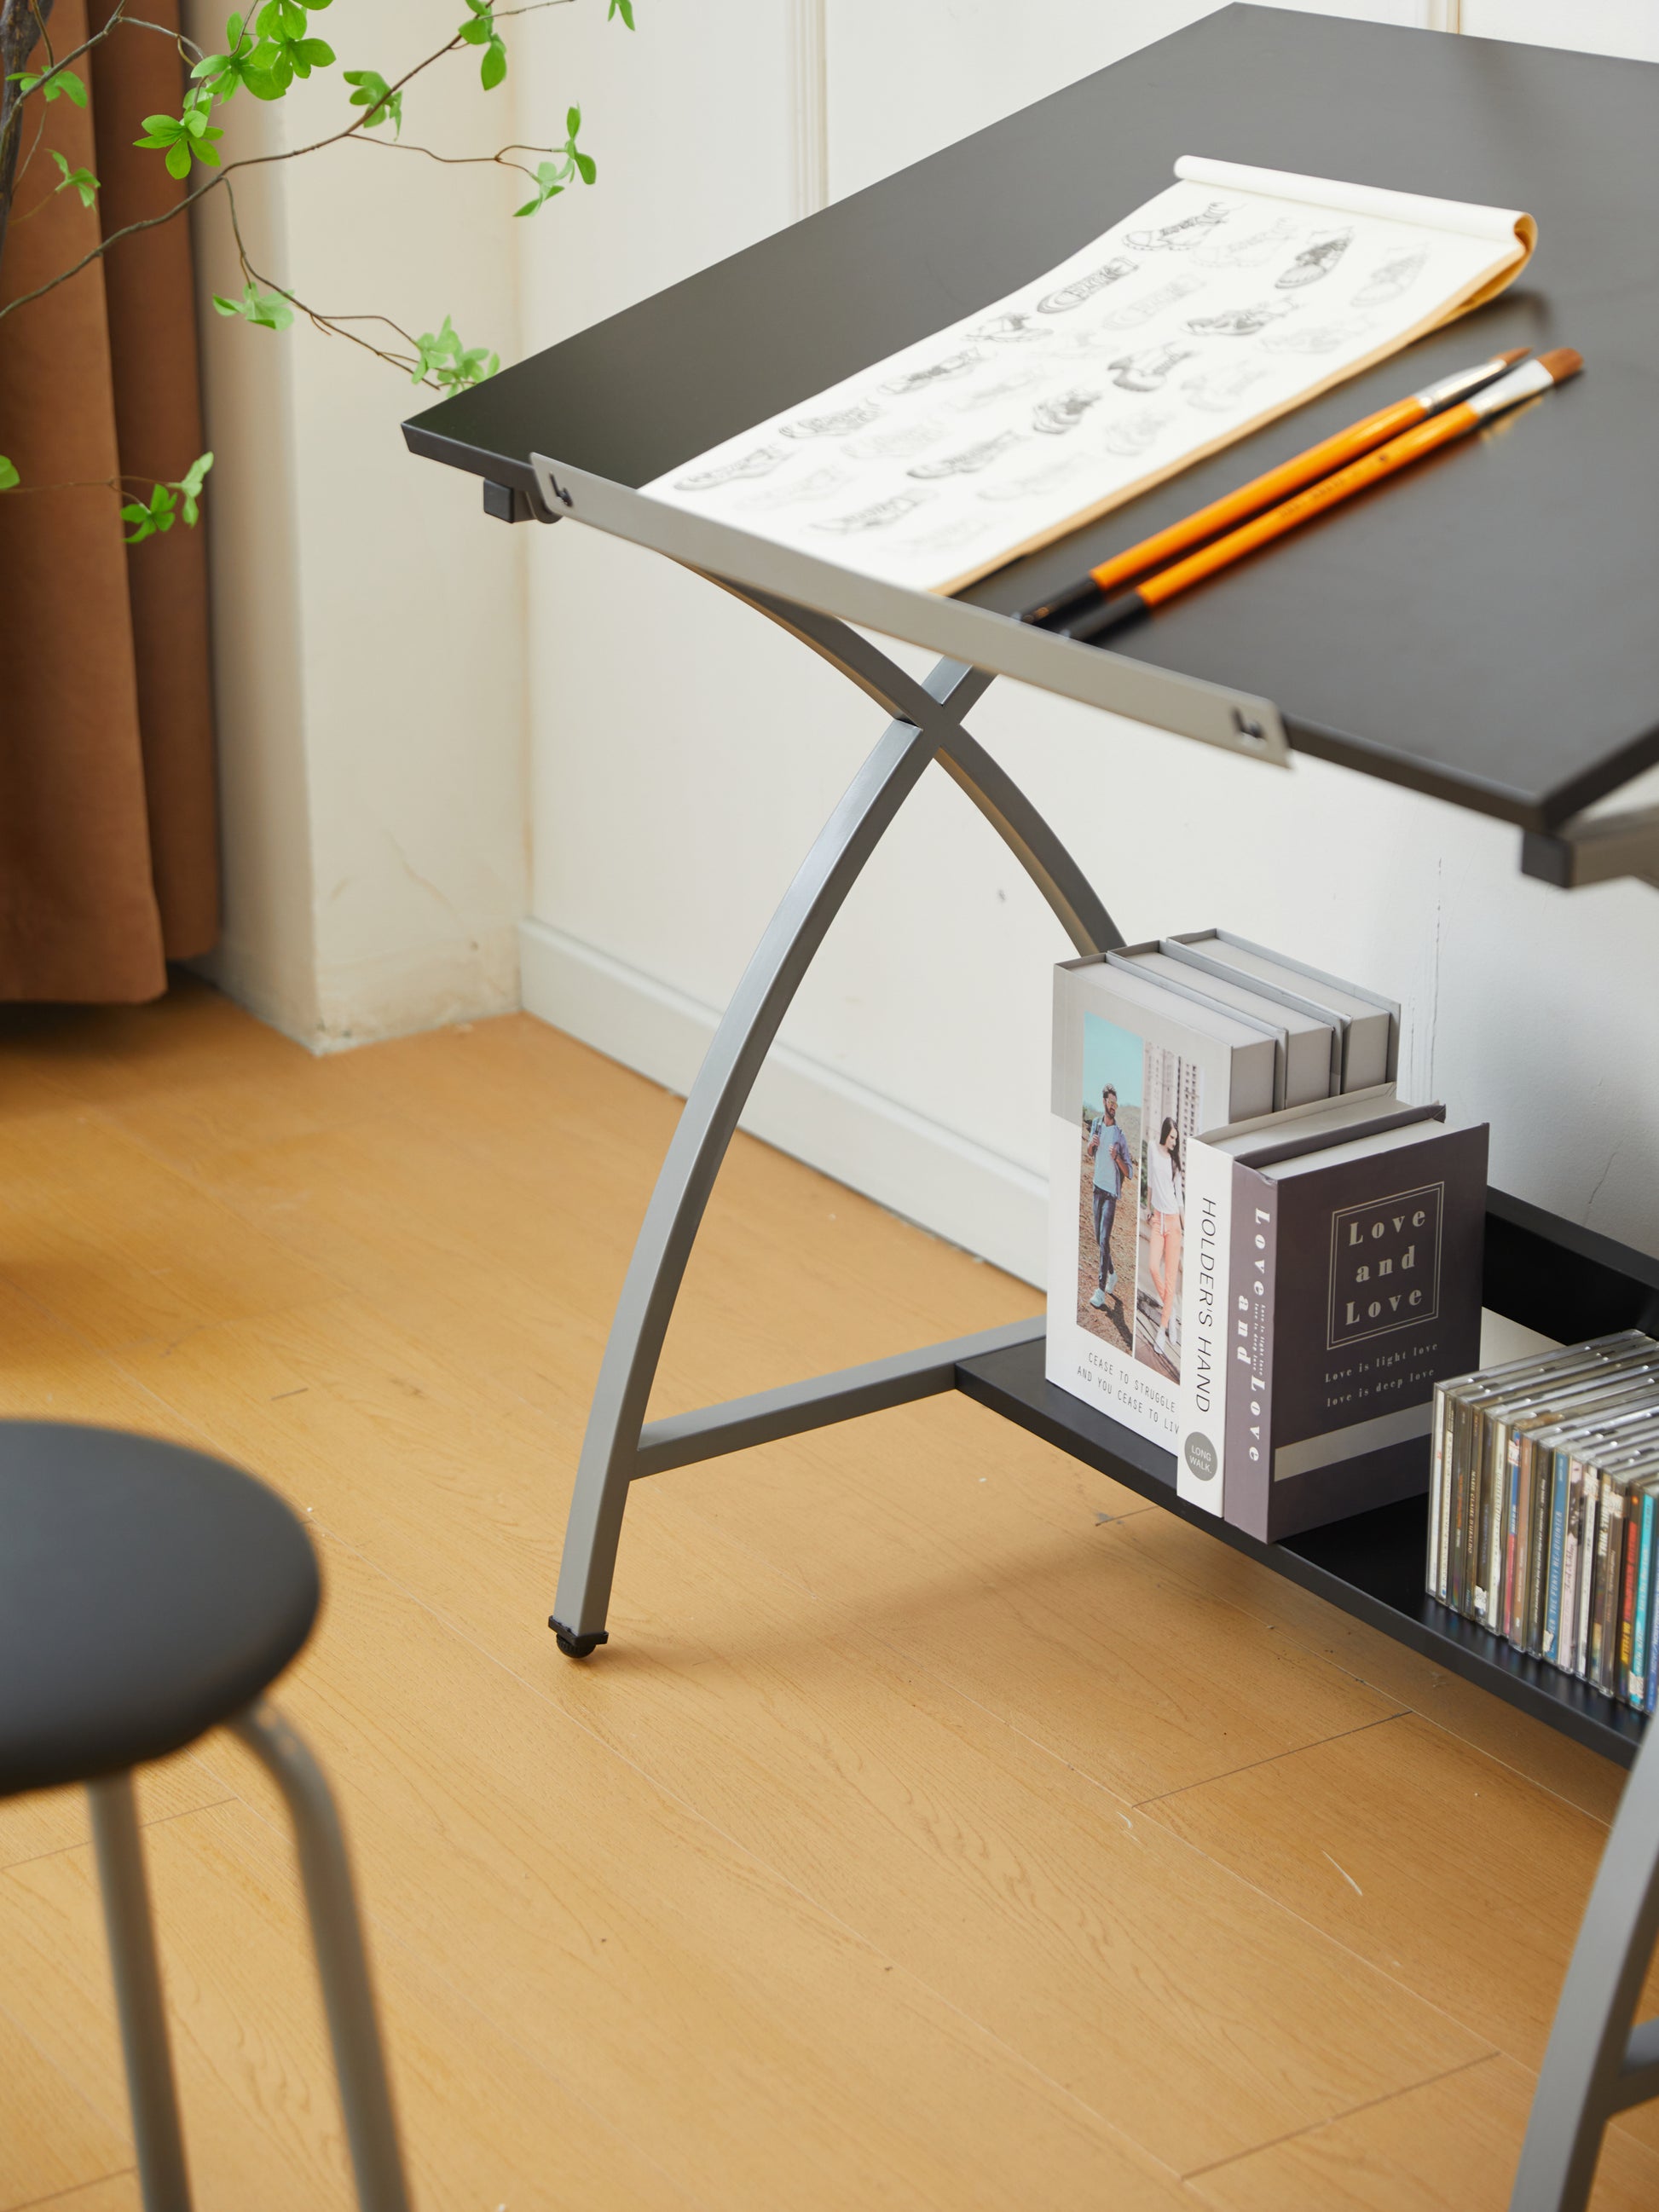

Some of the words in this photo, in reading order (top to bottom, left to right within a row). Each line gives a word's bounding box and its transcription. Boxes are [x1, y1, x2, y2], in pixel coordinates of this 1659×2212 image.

[1253, 1207, 1270, 1296] Love
[1349, 1210, 1425, 1246] Love
[1198, 1197, 1217, 1327] HOLDER'S
[1356, 1245, 1415, 1283] and
[1237, 1295, 1251, 1365] and
[1345, 1289, 1423, 1325] Love
[1088, 1352, 1113, 1375] CEASE
[1119, 1371, 1129, 1384] TO
[1135, 1380, 1176, 1413] STRUGGLE
[1195, 1337, 1211, 1412] HAND
[1325, 1368, 1352, 1383] Love
[1359, 1363, 1369, 1373] is
[1376, 1351, 1407, 1367] light
[1413, 1343, 1438, 1356] love
[1327, 1393, 1352, 1407] love
[1359, 1388, 1369, 1398] is
[1375, 1378, 1403, 1393] deep
[1409, 1368, 1435, 1383] love
[1077, 1366, 1092, 1382] AND
[1098, 1377, 1113, 1395] YOU
[1117, 1390, 1143, 1413] CEASE
[1148, 1409, 1159, 1423] TO
[1164, 1422, 1180, 1435] LIV
[1249, 1375, 1265, 1462] Love
[1191, 1445, 1211, 1462] LONG
